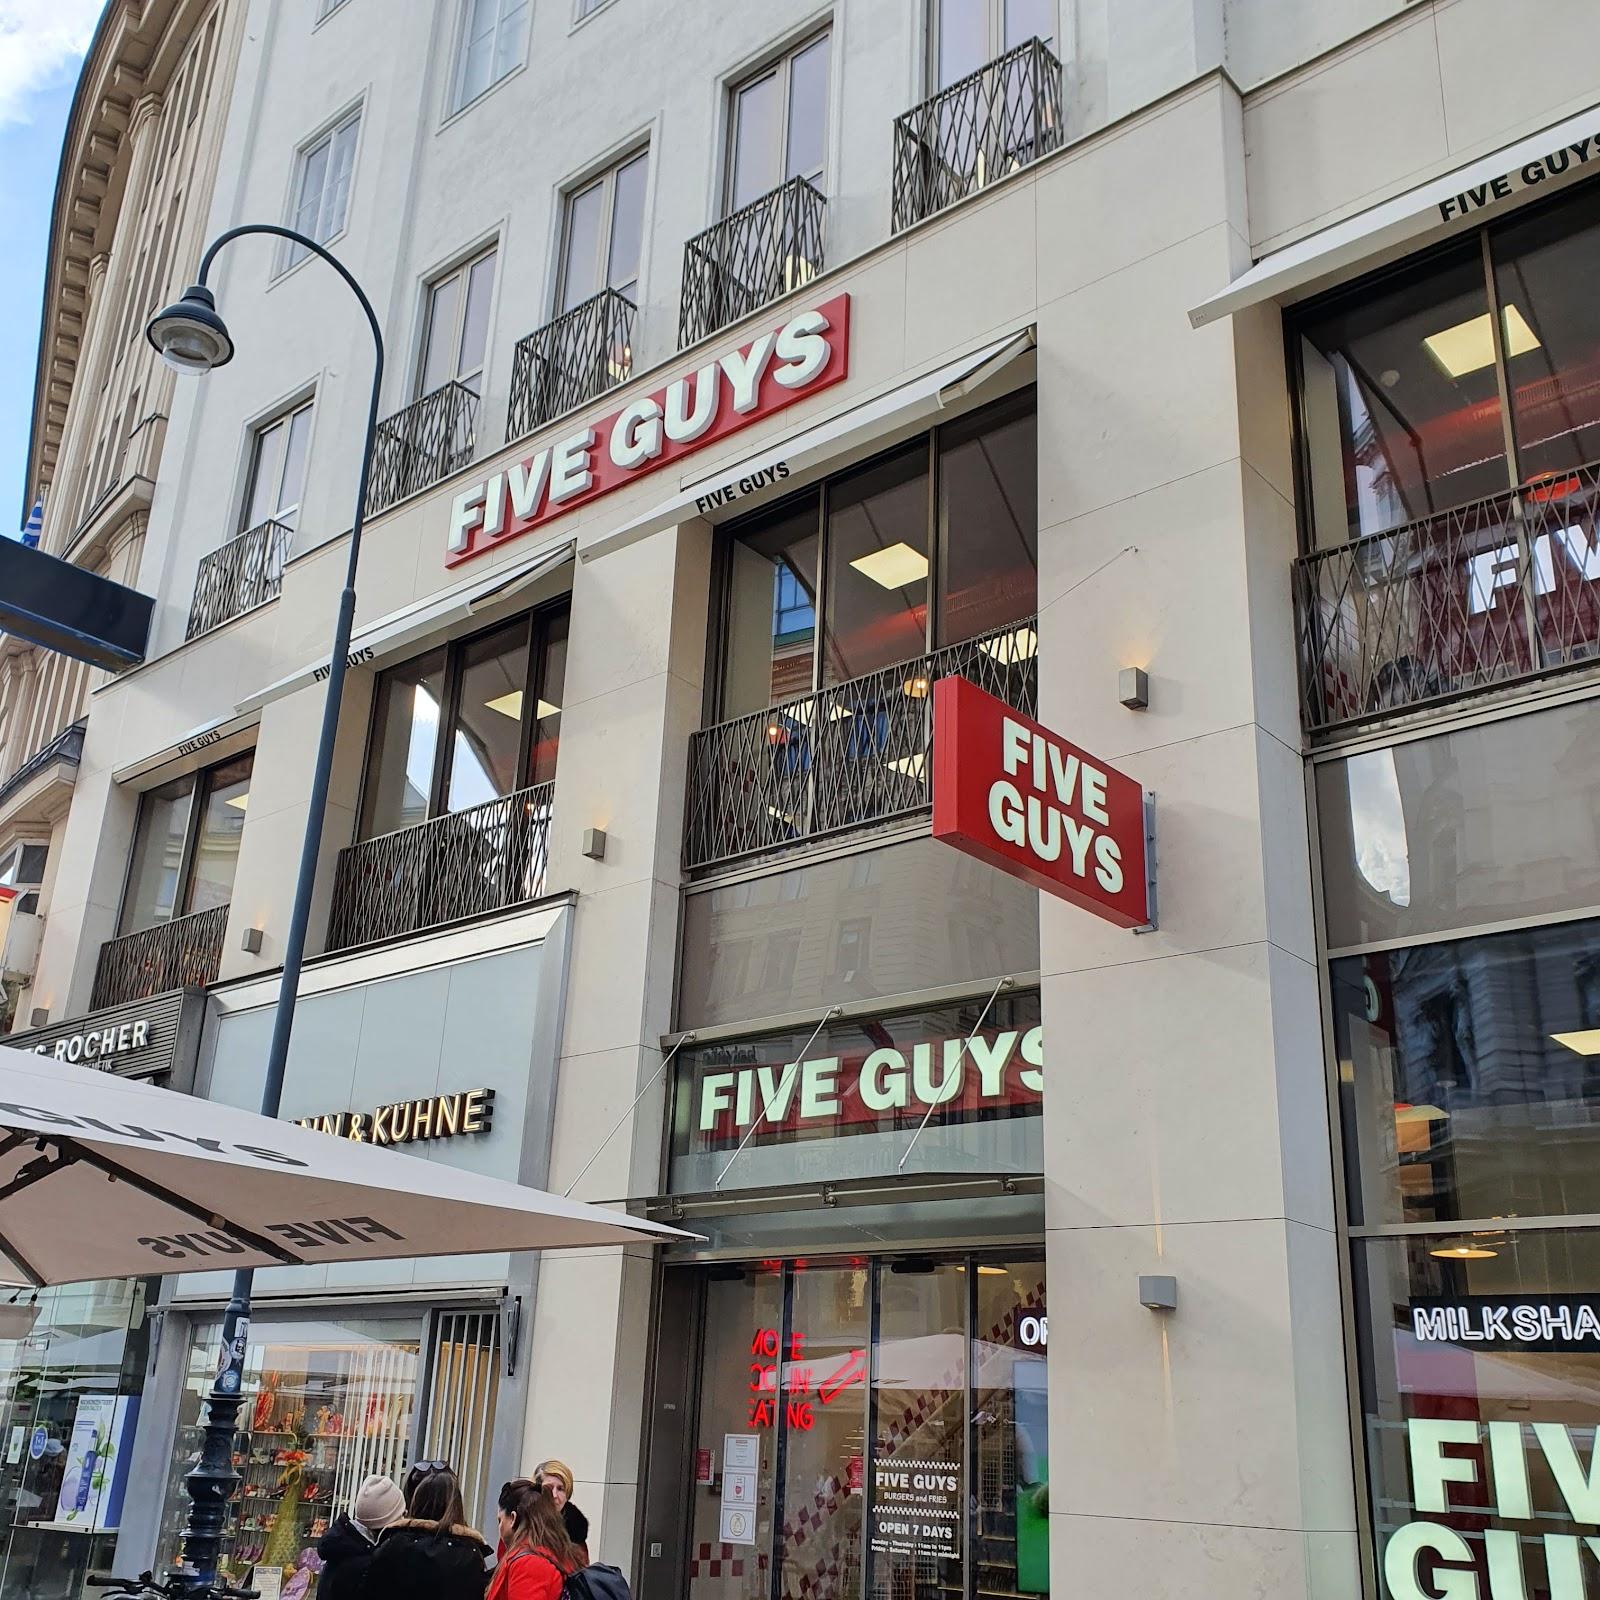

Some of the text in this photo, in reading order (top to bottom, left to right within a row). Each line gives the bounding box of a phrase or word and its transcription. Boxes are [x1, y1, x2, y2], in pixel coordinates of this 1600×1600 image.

[1439, 174, 1513, 222] FIVE
[447, 310, 832, 555] FIVE GUYS
[695, 461, 790, 514] FIVE GUYS
[312, 663, 332, 682] FIV
[178, 730, 221, 756] FIVE GUYS
[1003, 716, 1109, 827] FIVE
[988, 780, 1124, 894] GUYS
[53, 1020, 150, 1062] ROCHER
[699, 1056, 842, 1131] FIVE
[348, 1111, 366, 1142] &
[372, 1087, 493, 1145] KÜHNE
[1413, 1304, 1600, 1342] MILKSHA
[876, 1472, 957, 1492] FIVE GUYS
[884, 1492, 914, 1502] BURGERS
[929, 1495, 947, 1503] FRIES
[872, 1538, 888, 1546] Sunday
[893, 1540, 914, 1548] Thursday
[879, 1522, 952, 1539] OPEN 7 DAYS
